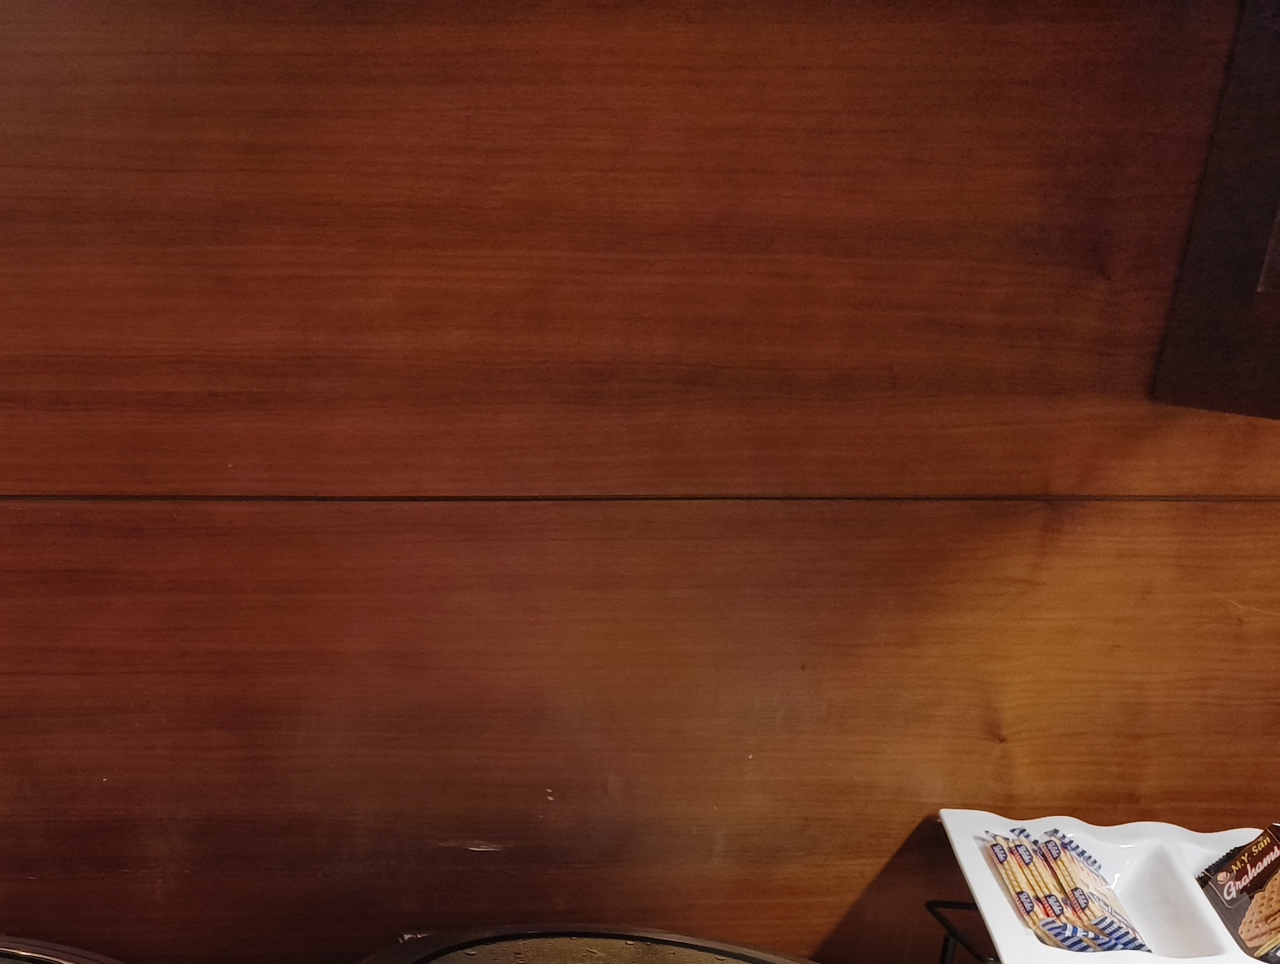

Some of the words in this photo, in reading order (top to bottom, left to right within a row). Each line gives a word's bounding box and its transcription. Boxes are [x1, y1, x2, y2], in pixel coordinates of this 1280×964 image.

[1223, 845, 1280, 901] Grahams
[1231, 852, 1252, 874] M.Y.
[1252, 836, 1271, 856] San
